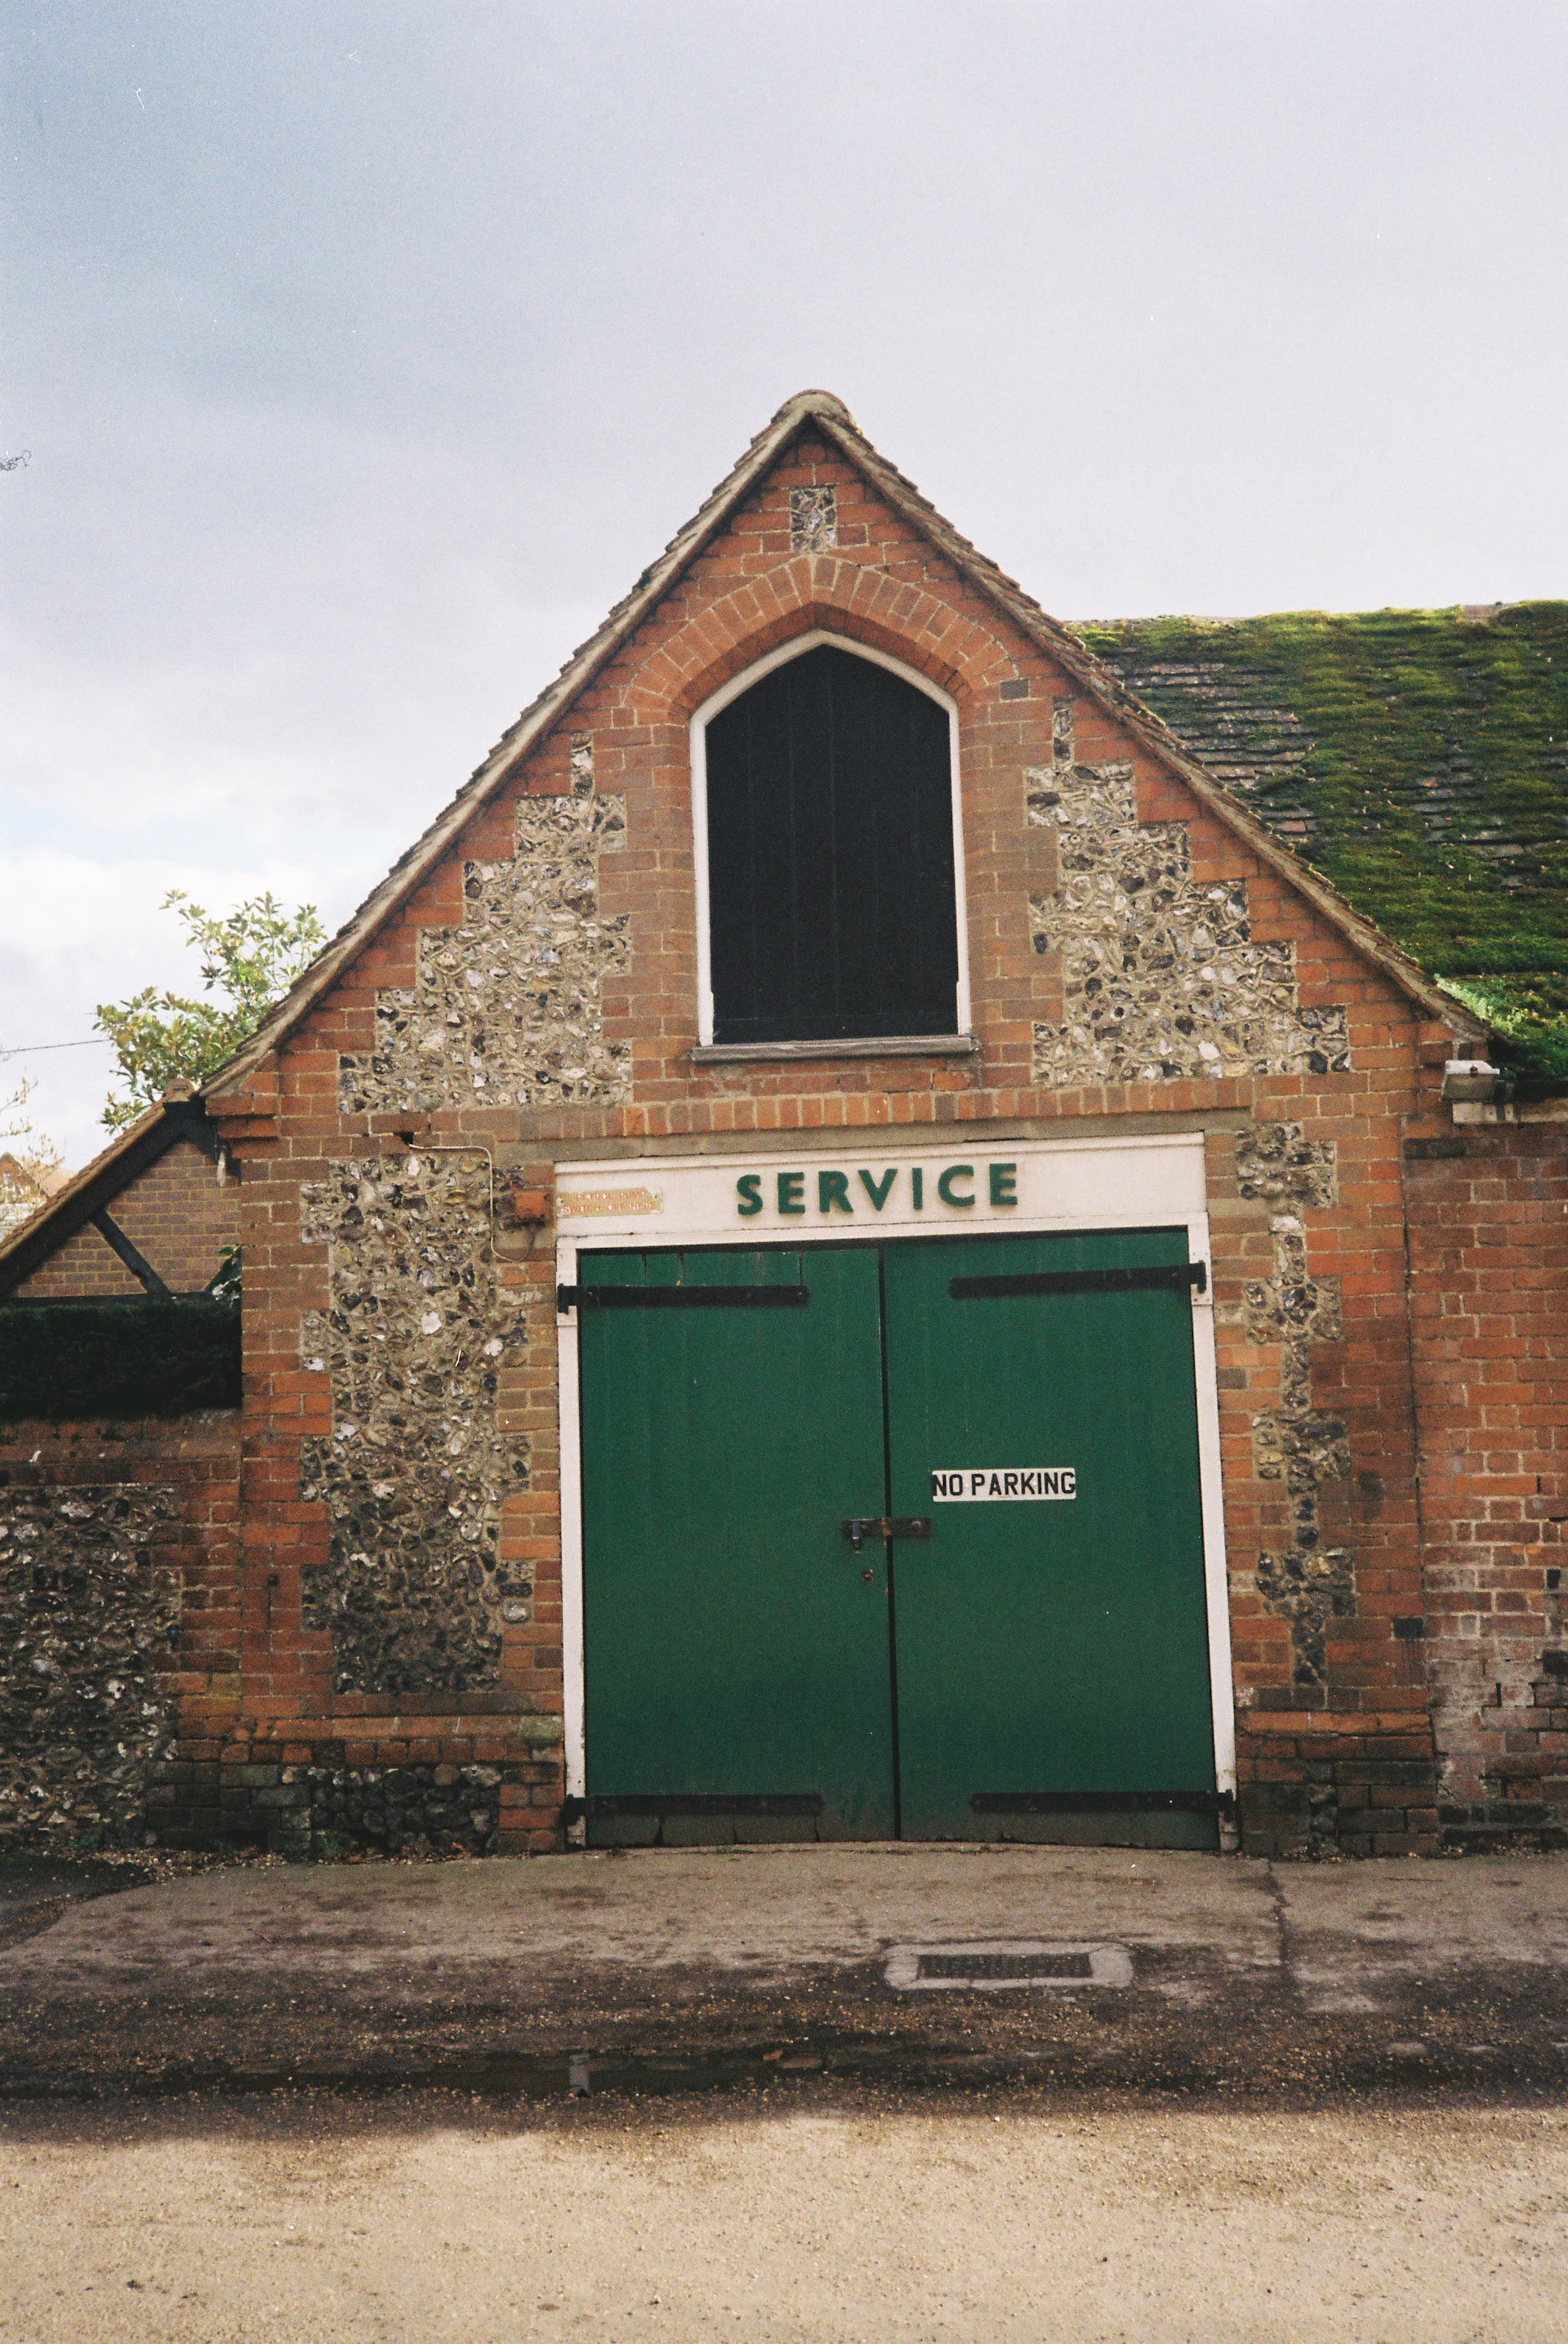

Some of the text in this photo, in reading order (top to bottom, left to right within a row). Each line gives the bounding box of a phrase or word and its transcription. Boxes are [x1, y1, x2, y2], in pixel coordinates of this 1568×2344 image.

[619, 1190, 646, 1200] PUMP
[736, 1162, 1018, 1216] SERVICE
[932, 1471, 1076, 1496] NO PARKING
